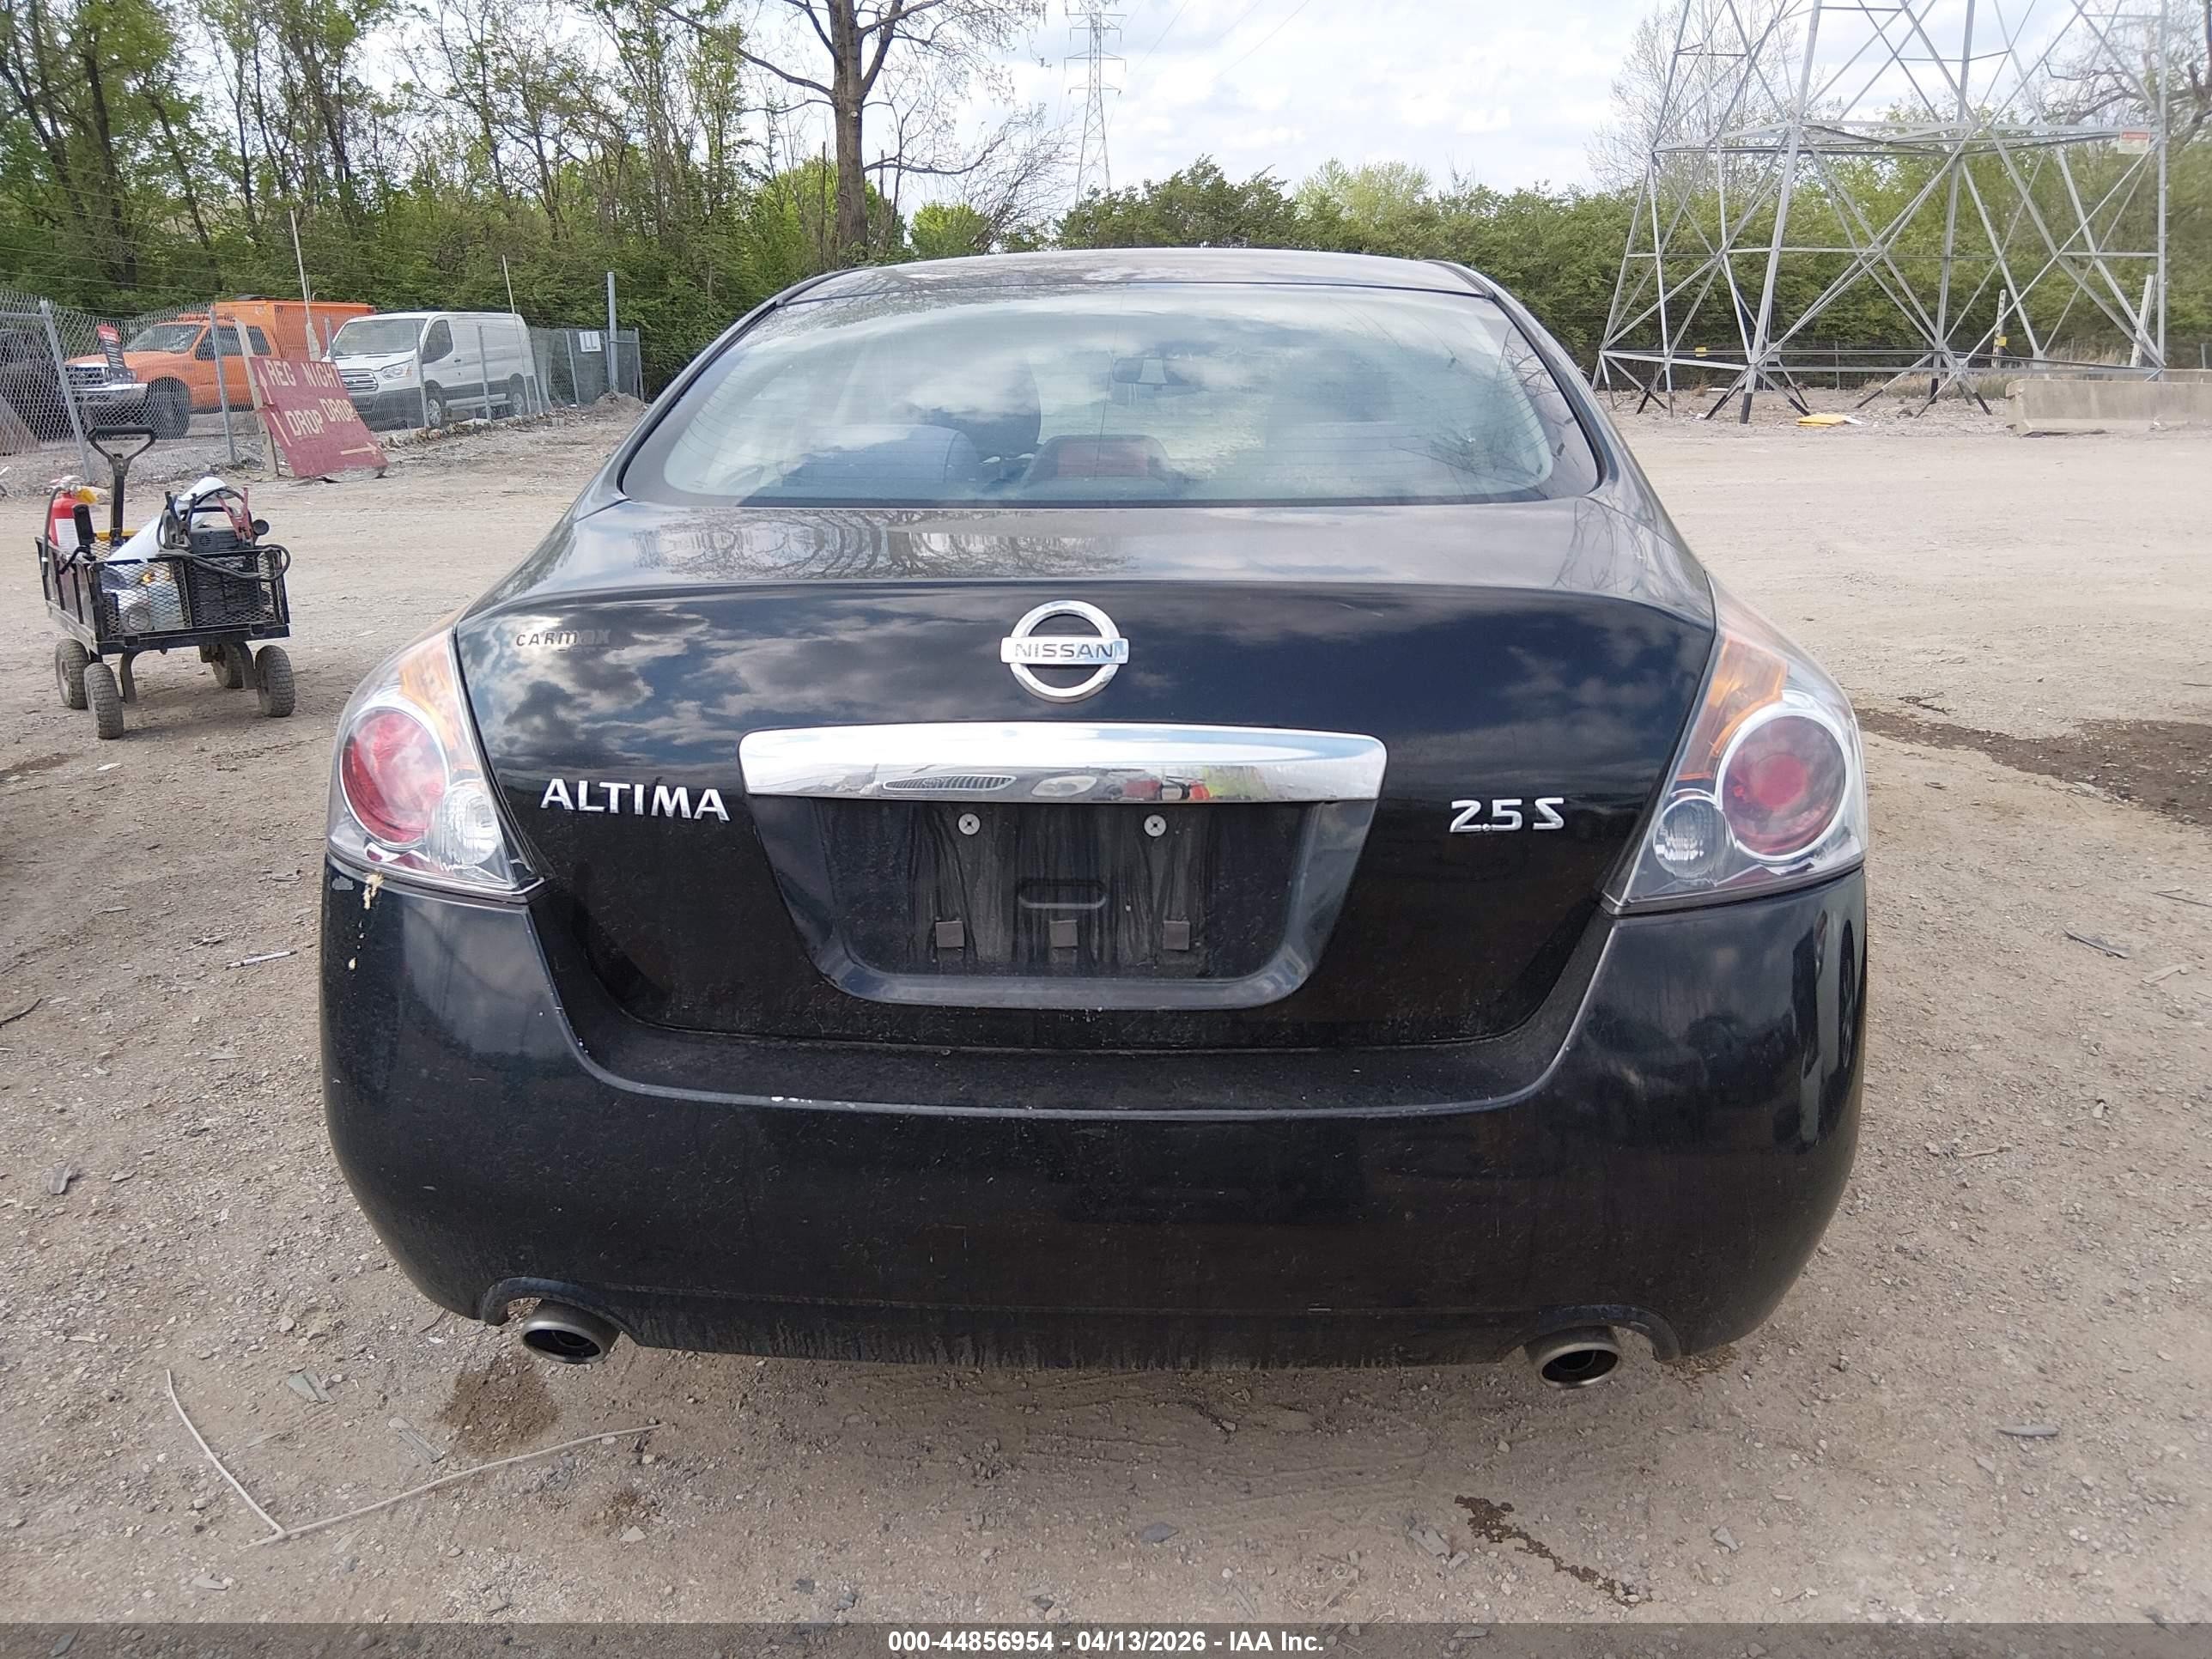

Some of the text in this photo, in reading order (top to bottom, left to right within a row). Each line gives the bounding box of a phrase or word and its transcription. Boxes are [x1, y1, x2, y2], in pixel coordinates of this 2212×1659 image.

[301, 362, 343, 388] NIGHT
[284, 410, 325, 436] DROP
[319, 398, 356, 422] DROP
[1014, 643, 1114, 659] NISSAN
[539, 777, 731, 823] ALTIMA
[1449, 797, 1565, 833] 2.5 S
